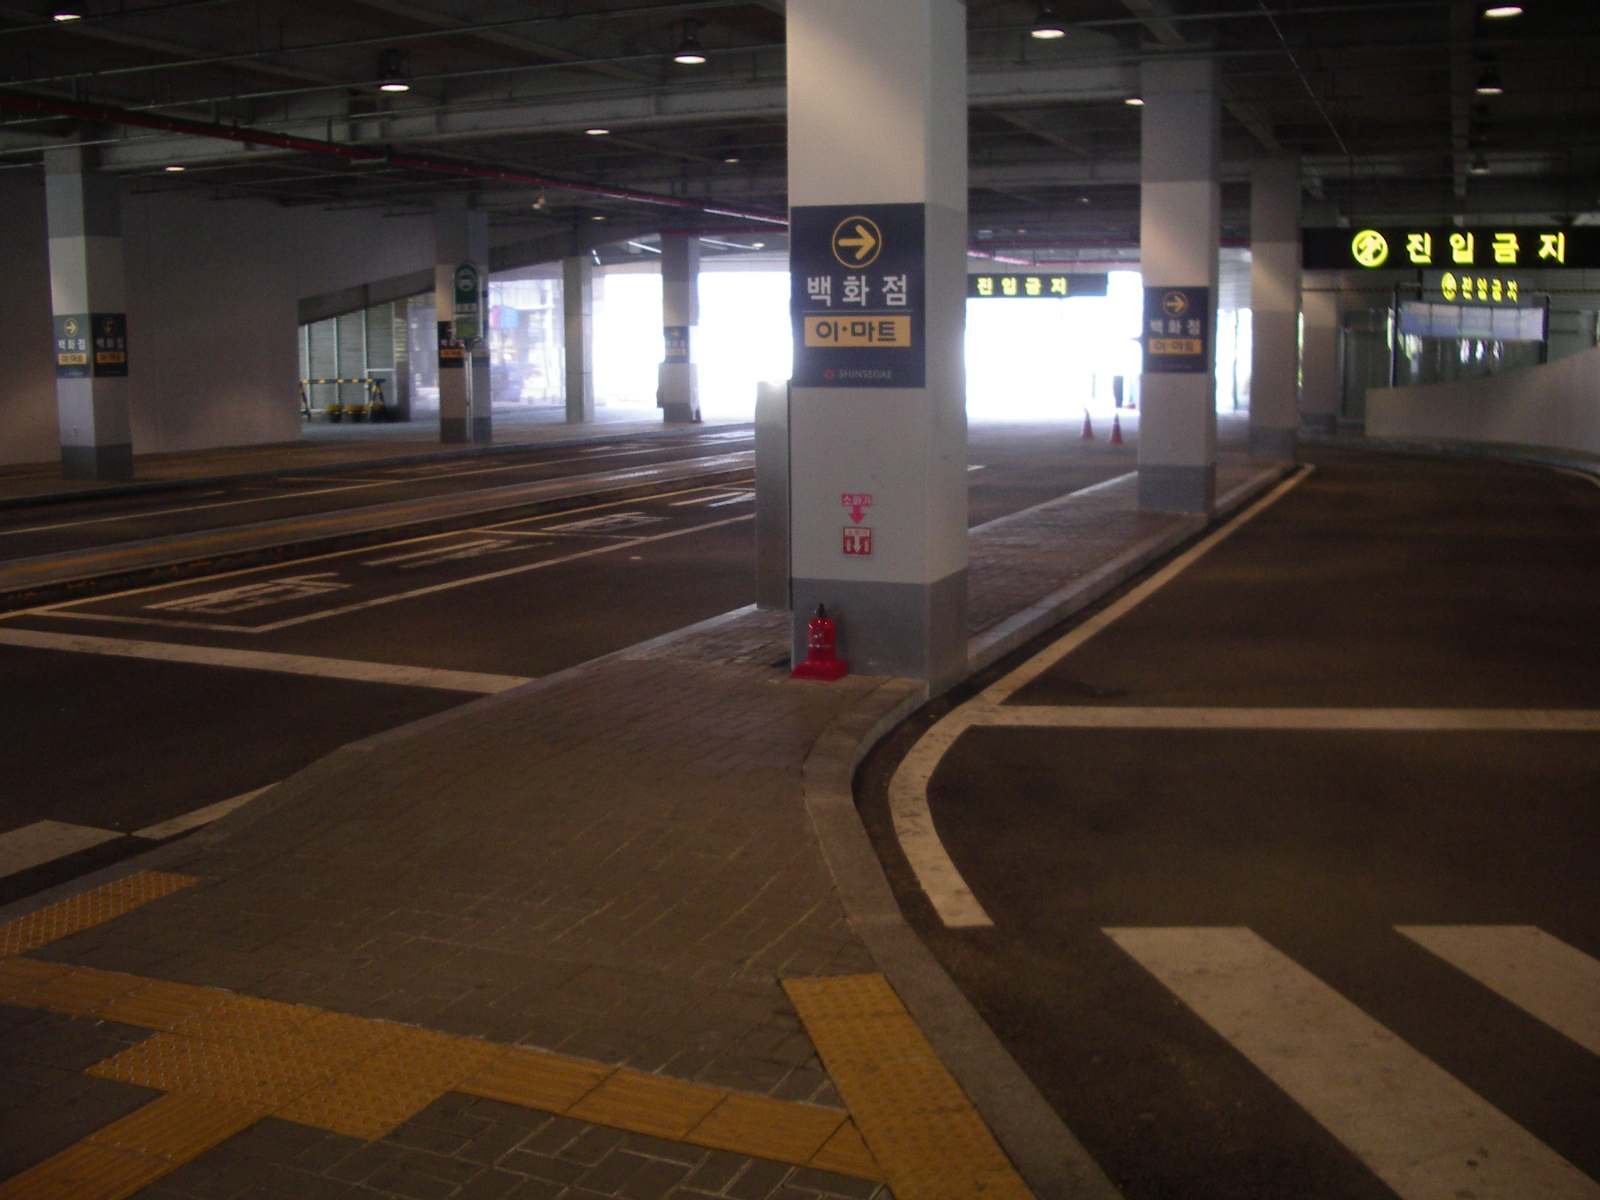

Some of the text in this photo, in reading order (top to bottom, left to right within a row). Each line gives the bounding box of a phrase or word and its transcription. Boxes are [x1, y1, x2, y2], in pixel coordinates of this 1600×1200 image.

[1406, 231, 1567, 264] 진입금지
[807, 274, 907, 307] 백화점
[977, 276, 1067, 296] 진입금지
[839, 369, 893, 379] SHINSEGAE
